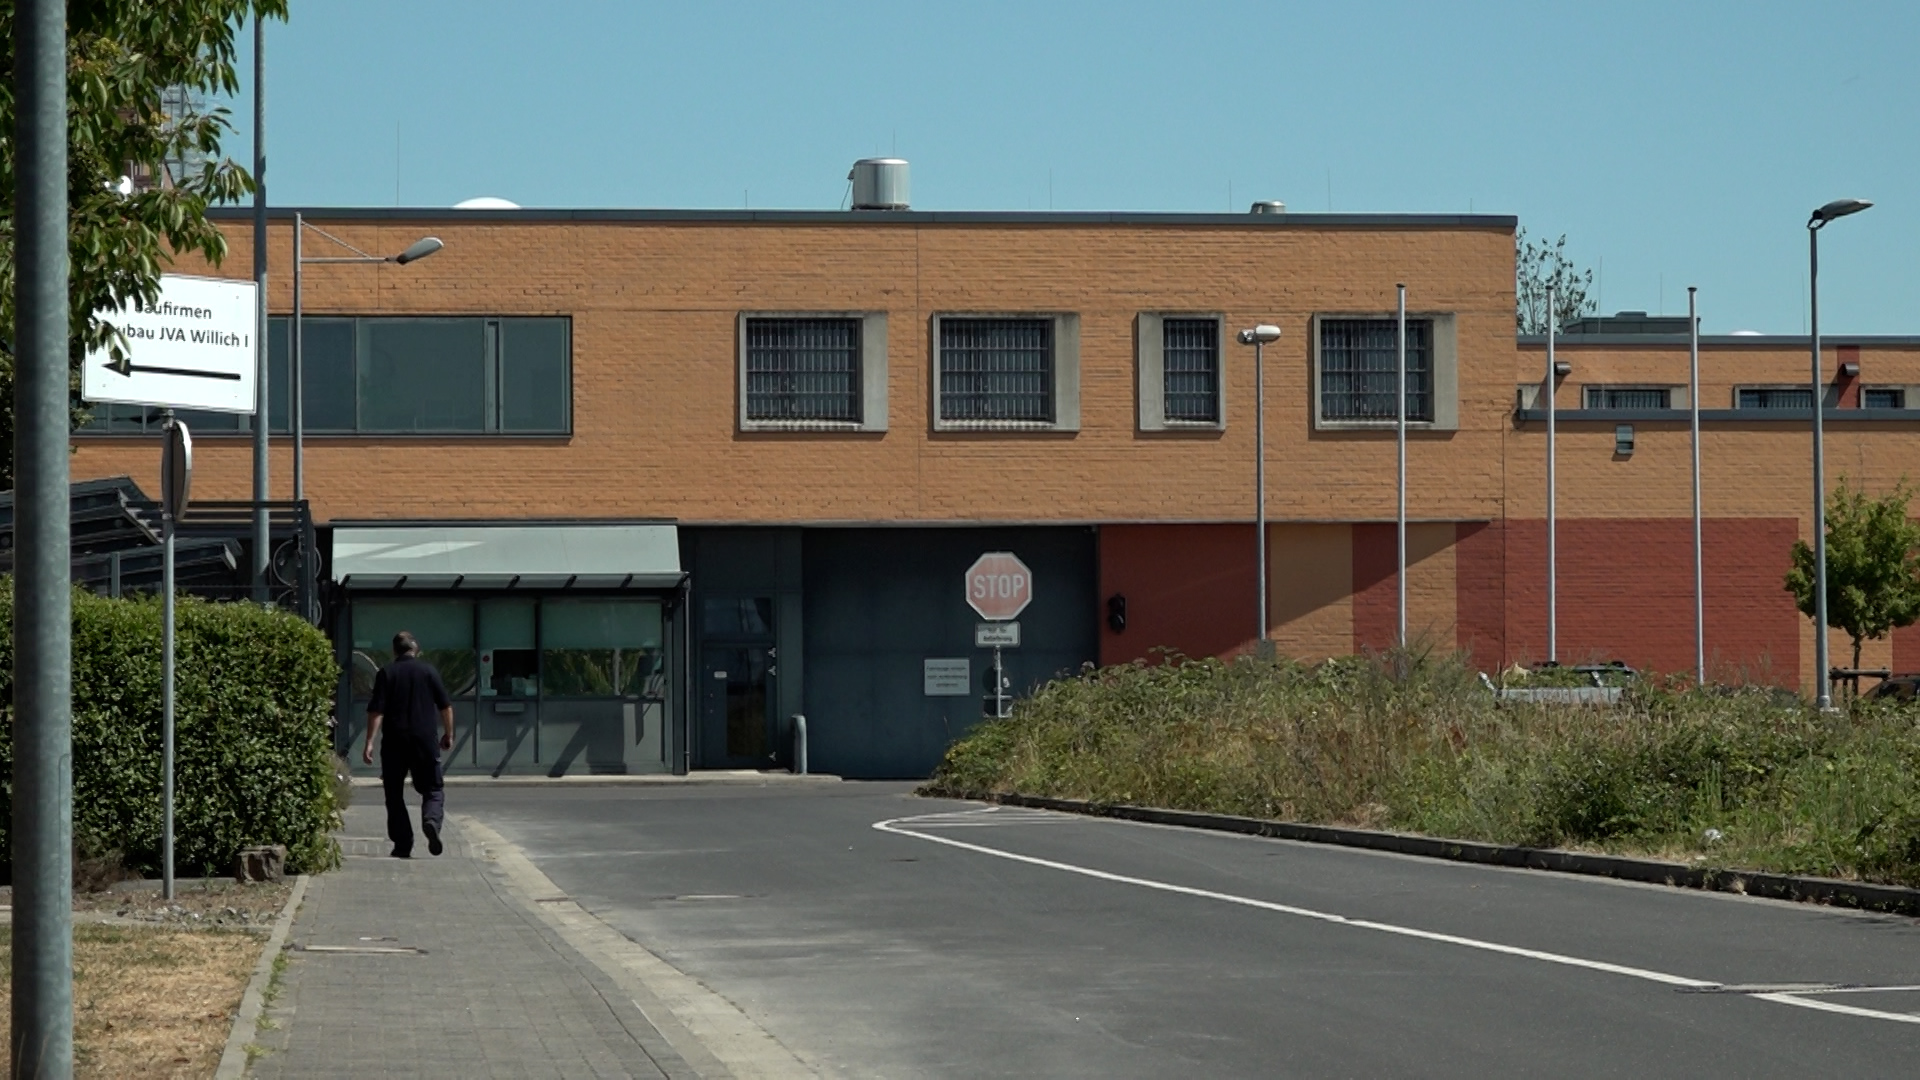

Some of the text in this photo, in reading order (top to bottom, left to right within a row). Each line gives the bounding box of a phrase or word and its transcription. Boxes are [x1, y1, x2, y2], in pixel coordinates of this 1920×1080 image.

[135, 301, 212, 320] aufirmen
[159, 326, 187, 342] JVA
[190, 329, 241, 348] Willich
[973, 574, 1025, 599] STOP
